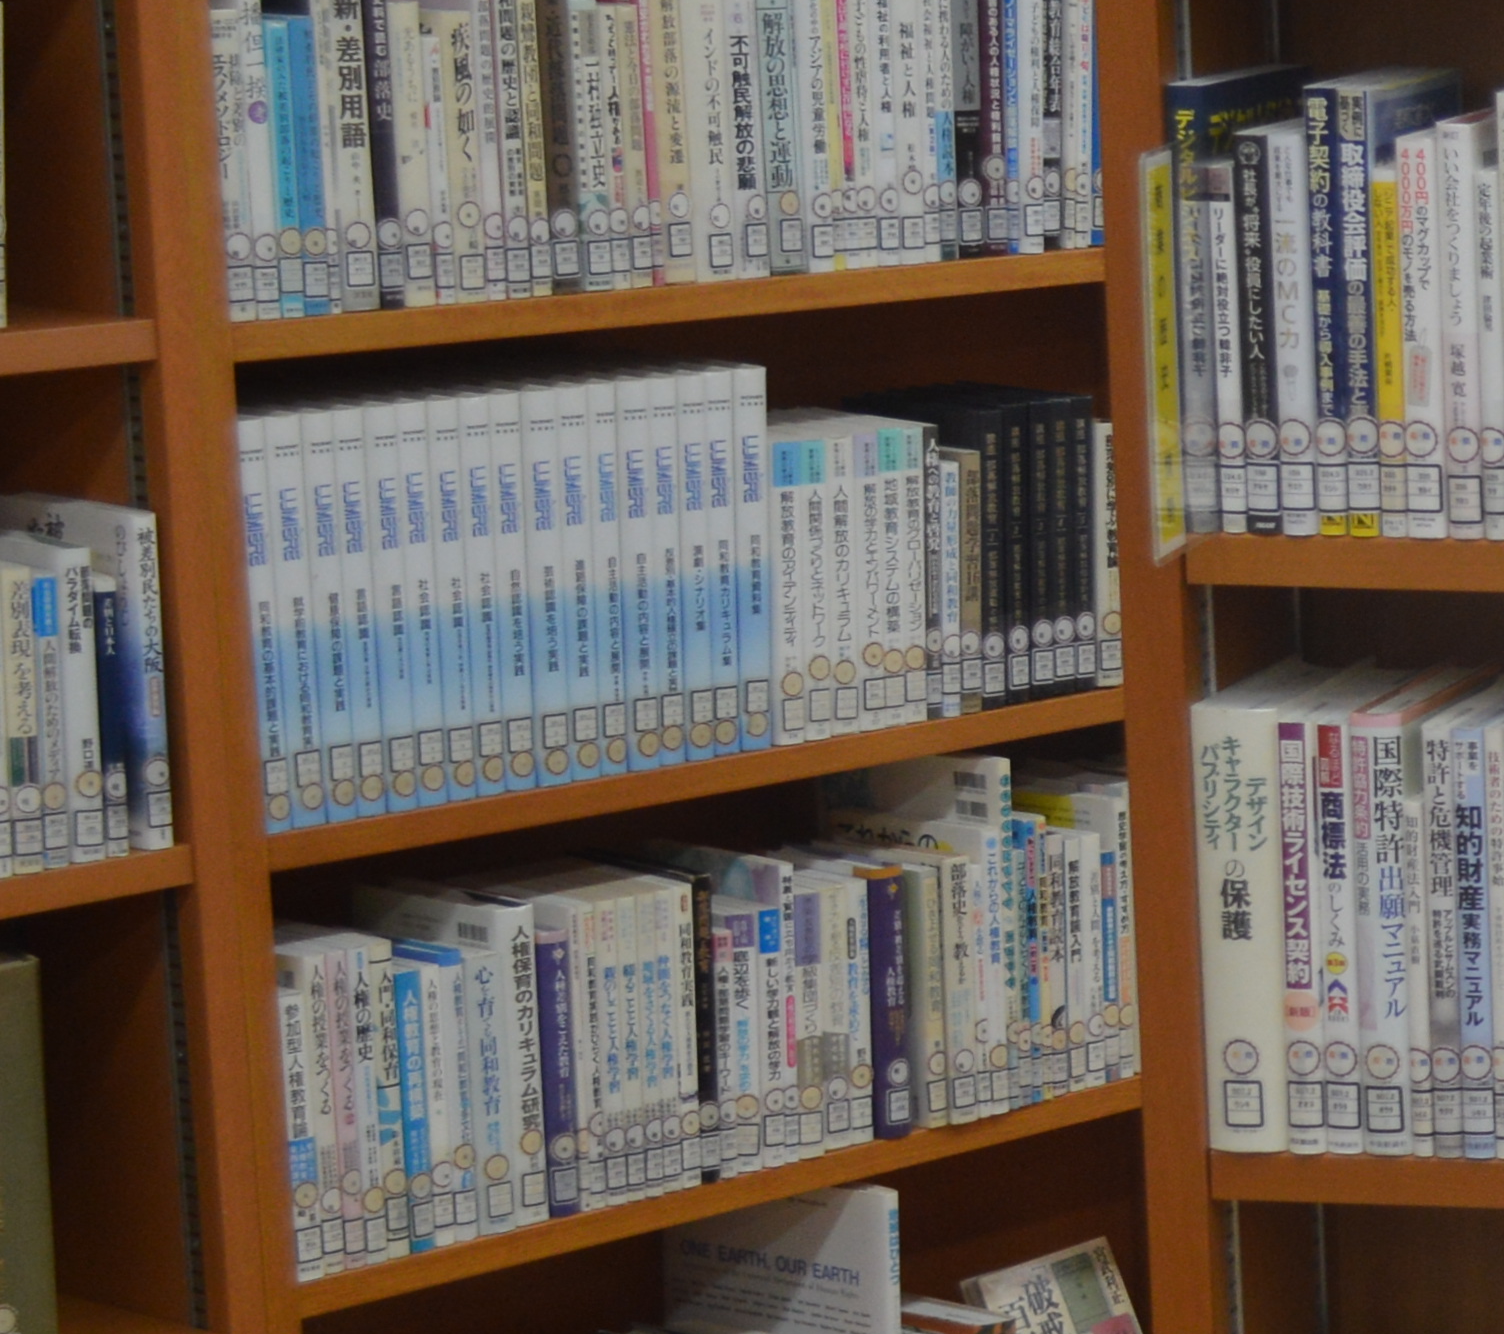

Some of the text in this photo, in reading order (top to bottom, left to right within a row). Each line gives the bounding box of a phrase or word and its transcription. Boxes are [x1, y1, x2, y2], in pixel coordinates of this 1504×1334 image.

[760, 11, 795, 192] 解放の思想と運動
[1278, 739, 1309, 986] 国際技術ライセンス契約
[1426, 739, 1453, 899] 特許と危機管理
[812, 1262, 861, 1287] EARTH
